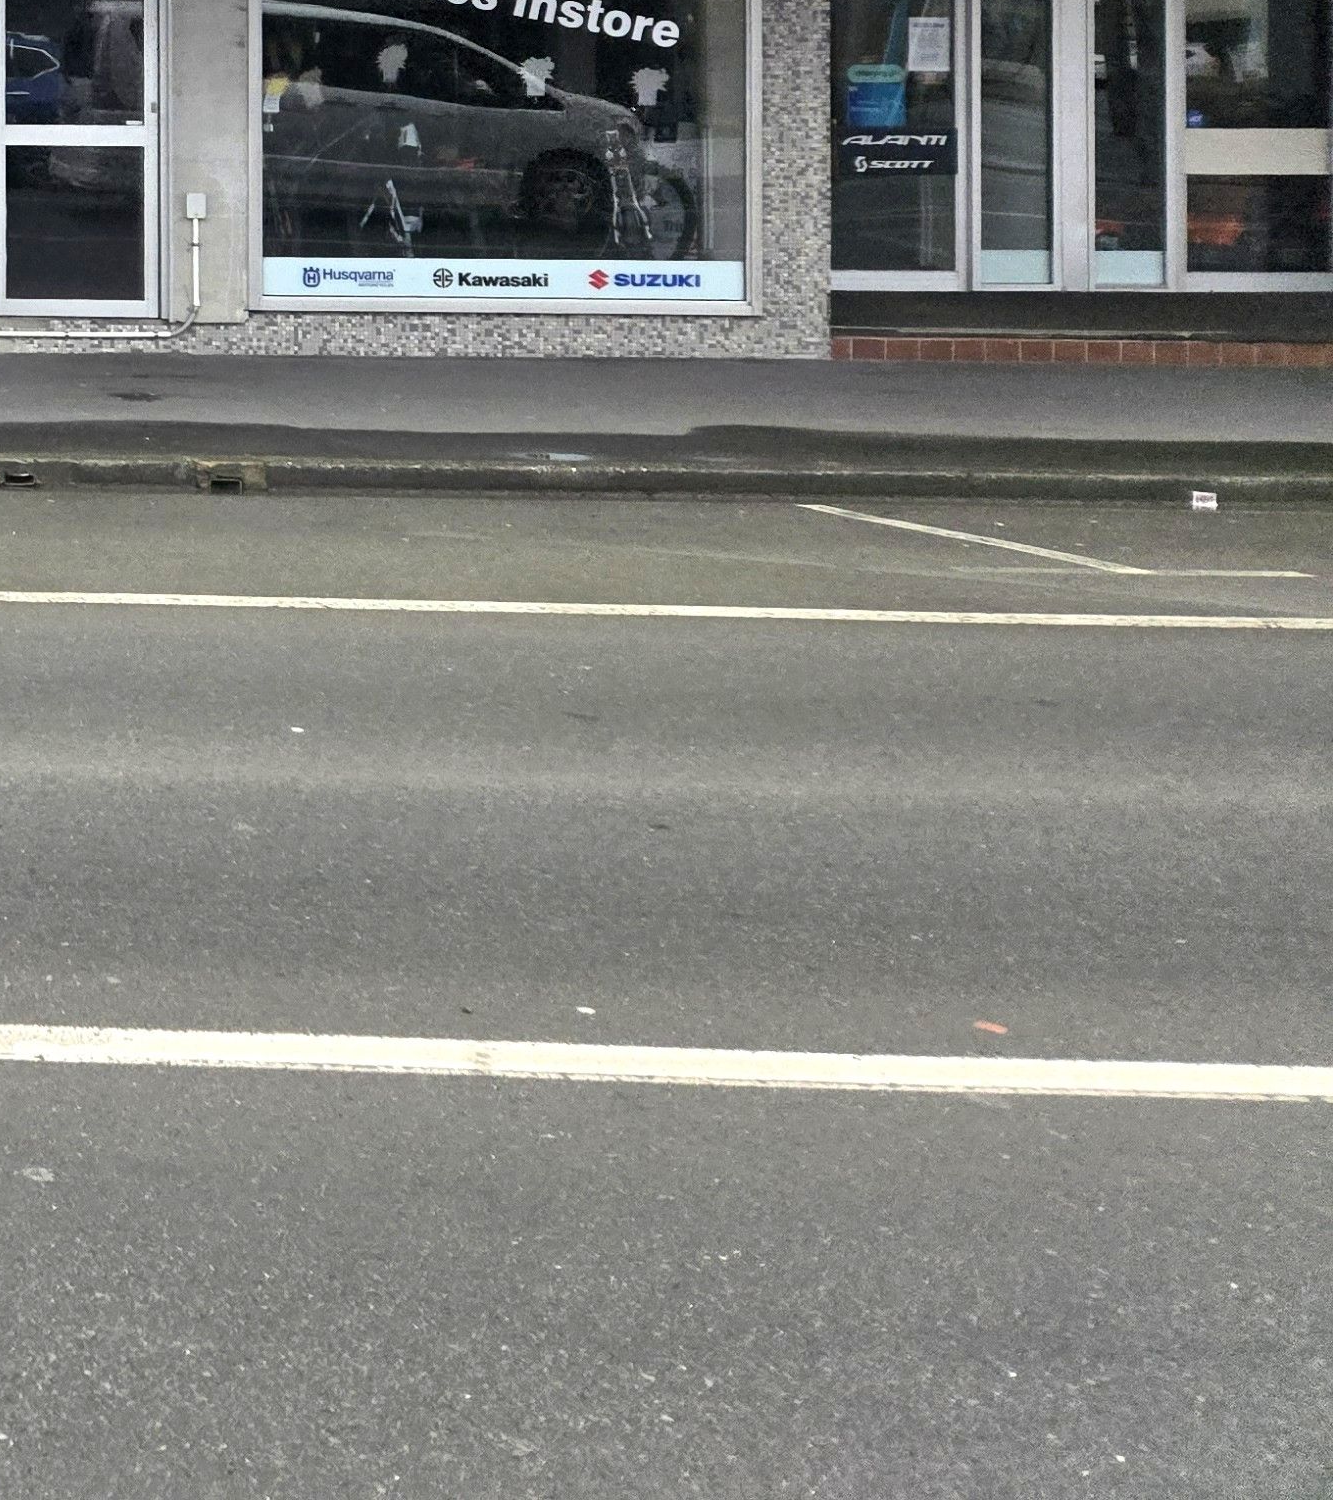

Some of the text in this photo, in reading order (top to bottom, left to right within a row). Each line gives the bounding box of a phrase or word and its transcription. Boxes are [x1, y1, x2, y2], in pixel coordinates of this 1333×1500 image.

[842, 134, 948, 146] AVANTI
[868, 160, 935, 169] SCOTT
[322, 268, 394, 283] Husqvarna
[458, 272, 549, 288] Kawasaki
[613, 273, 701, 288] SUZUKI
